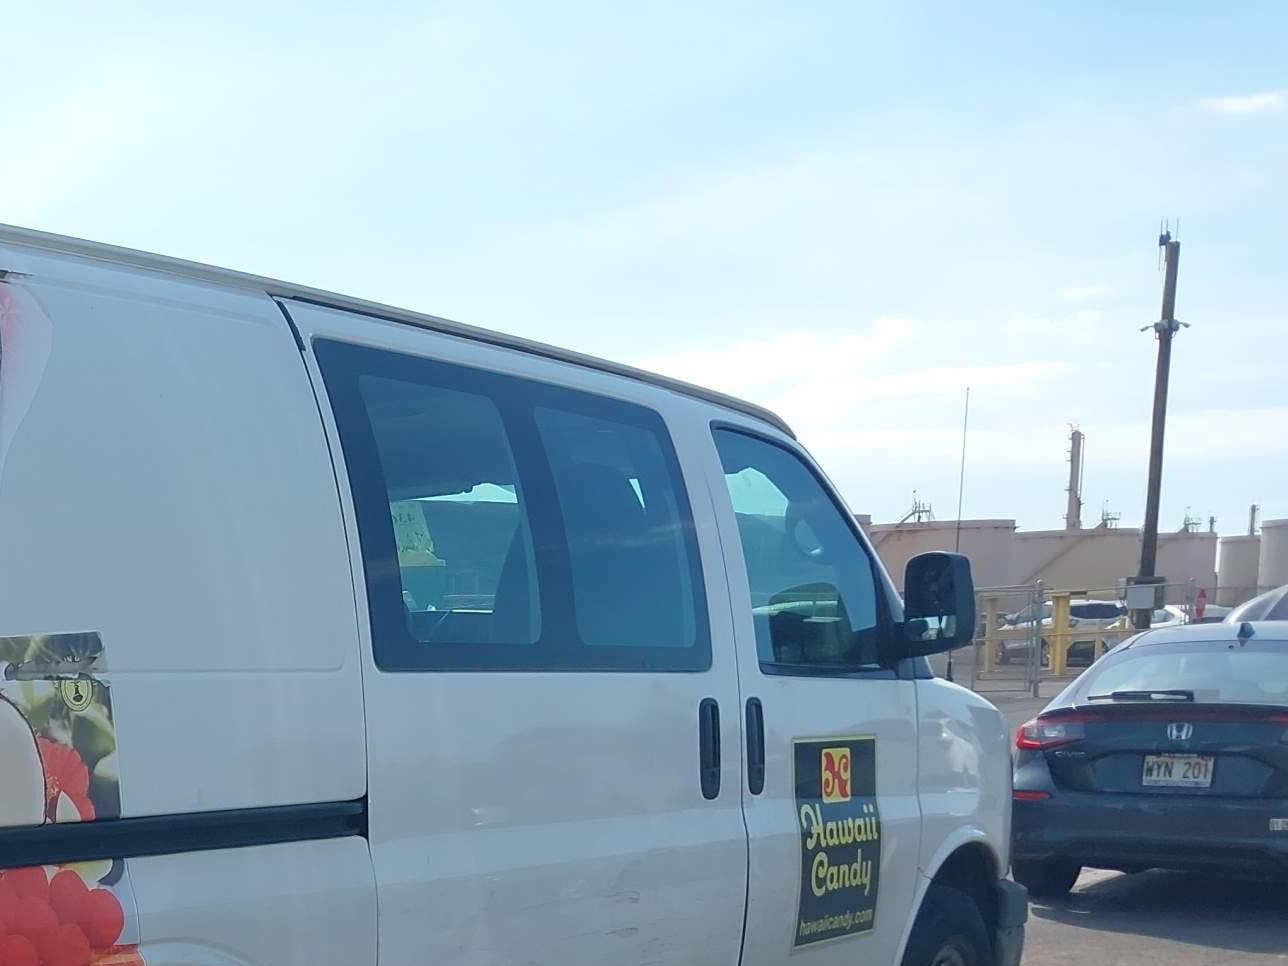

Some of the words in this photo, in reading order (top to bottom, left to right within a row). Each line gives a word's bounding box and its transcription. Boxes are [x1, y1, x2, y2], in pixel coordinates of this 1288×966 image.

[1145, 761, 1174, 777] WYN
[1183, 762, 1208, 779] 201
[801, 803, 878, 850] Hawaii
[812, 848, 872, 896] Candy
[799, 908, 873, 936] hawaiicandy.com
